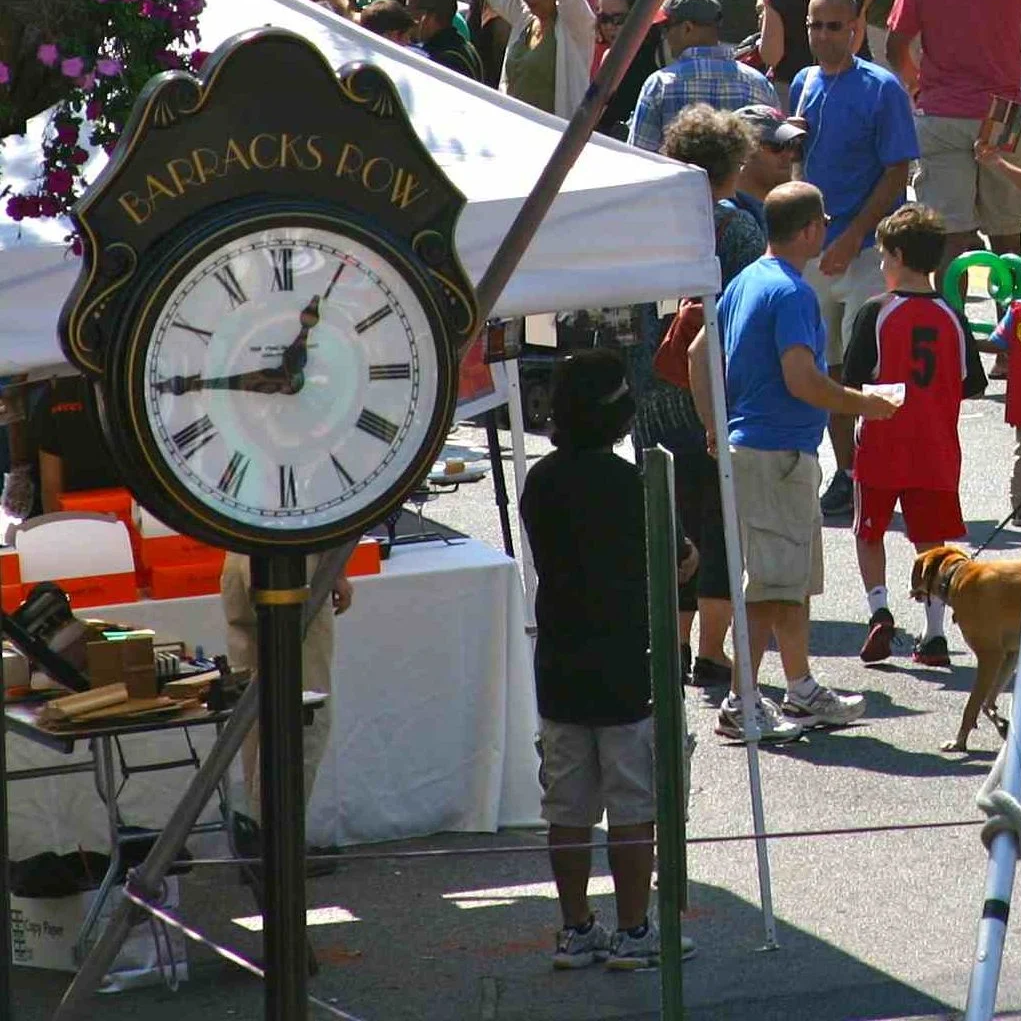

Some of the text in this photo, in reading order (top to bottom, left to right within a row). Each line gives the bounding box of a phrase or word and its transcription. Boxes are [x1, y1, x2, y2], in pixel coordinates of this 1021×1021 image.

[117, 133, 430, 226] BARRACKS ROW
[911, 327, 938, 387] 5
